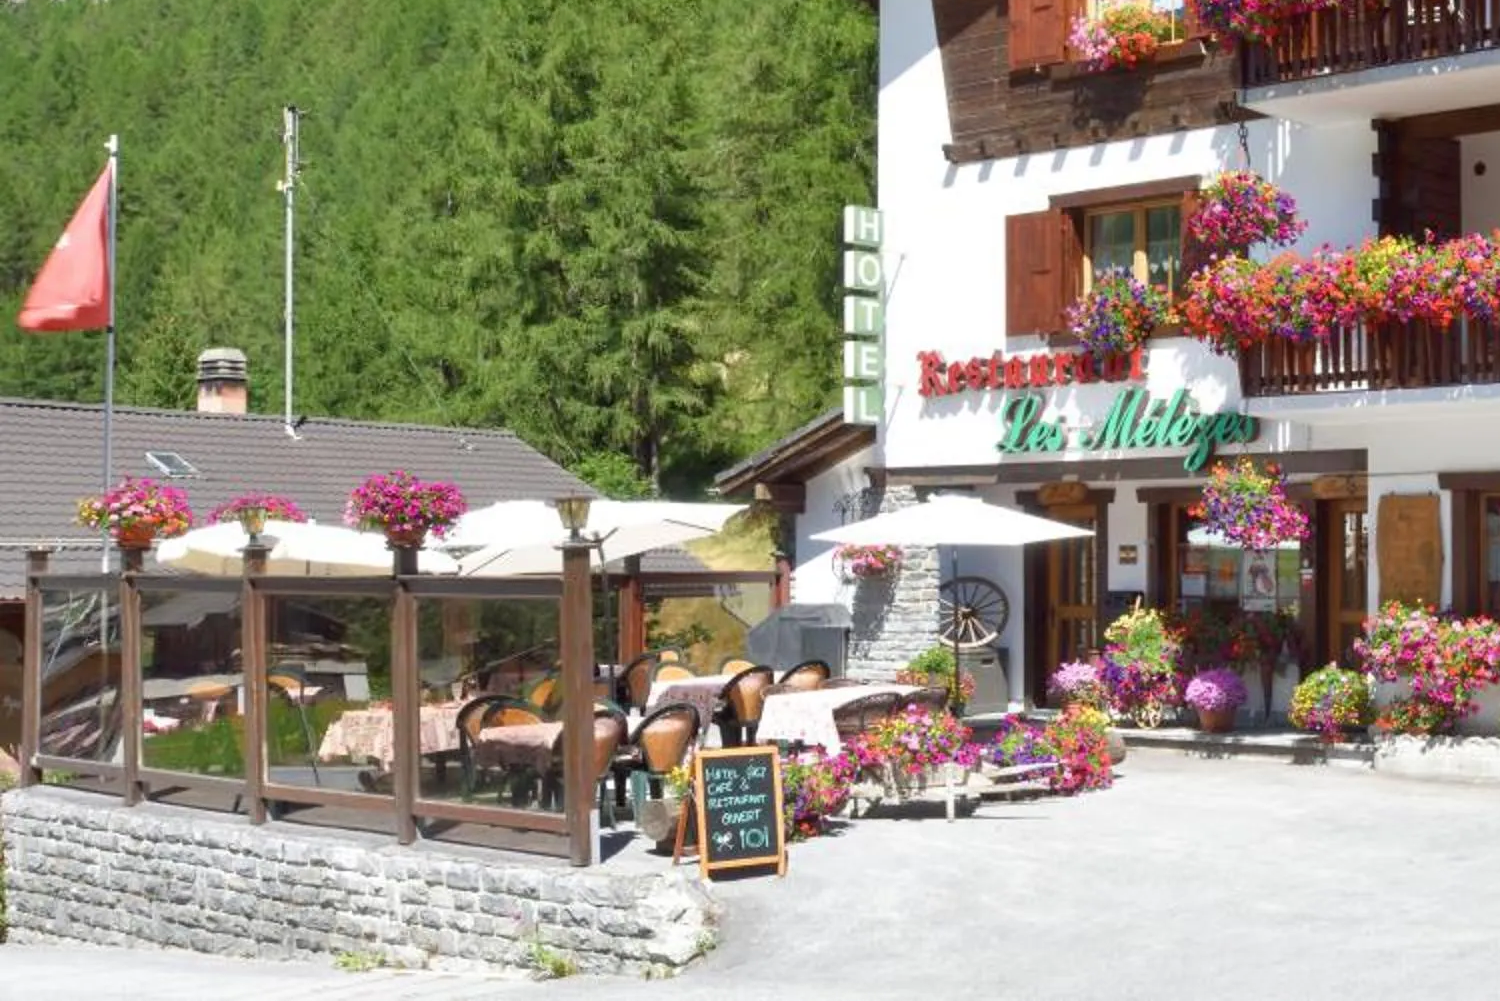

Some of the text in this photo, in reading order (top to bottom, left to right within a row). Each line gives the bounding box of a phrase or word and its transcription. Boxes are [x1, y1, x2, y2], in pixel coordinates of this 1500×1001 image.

[858, 208, 882, 423] HOTEL
[917, 349, 1145, 397] Restaurant
[996, 396, 1066, 453] Les
